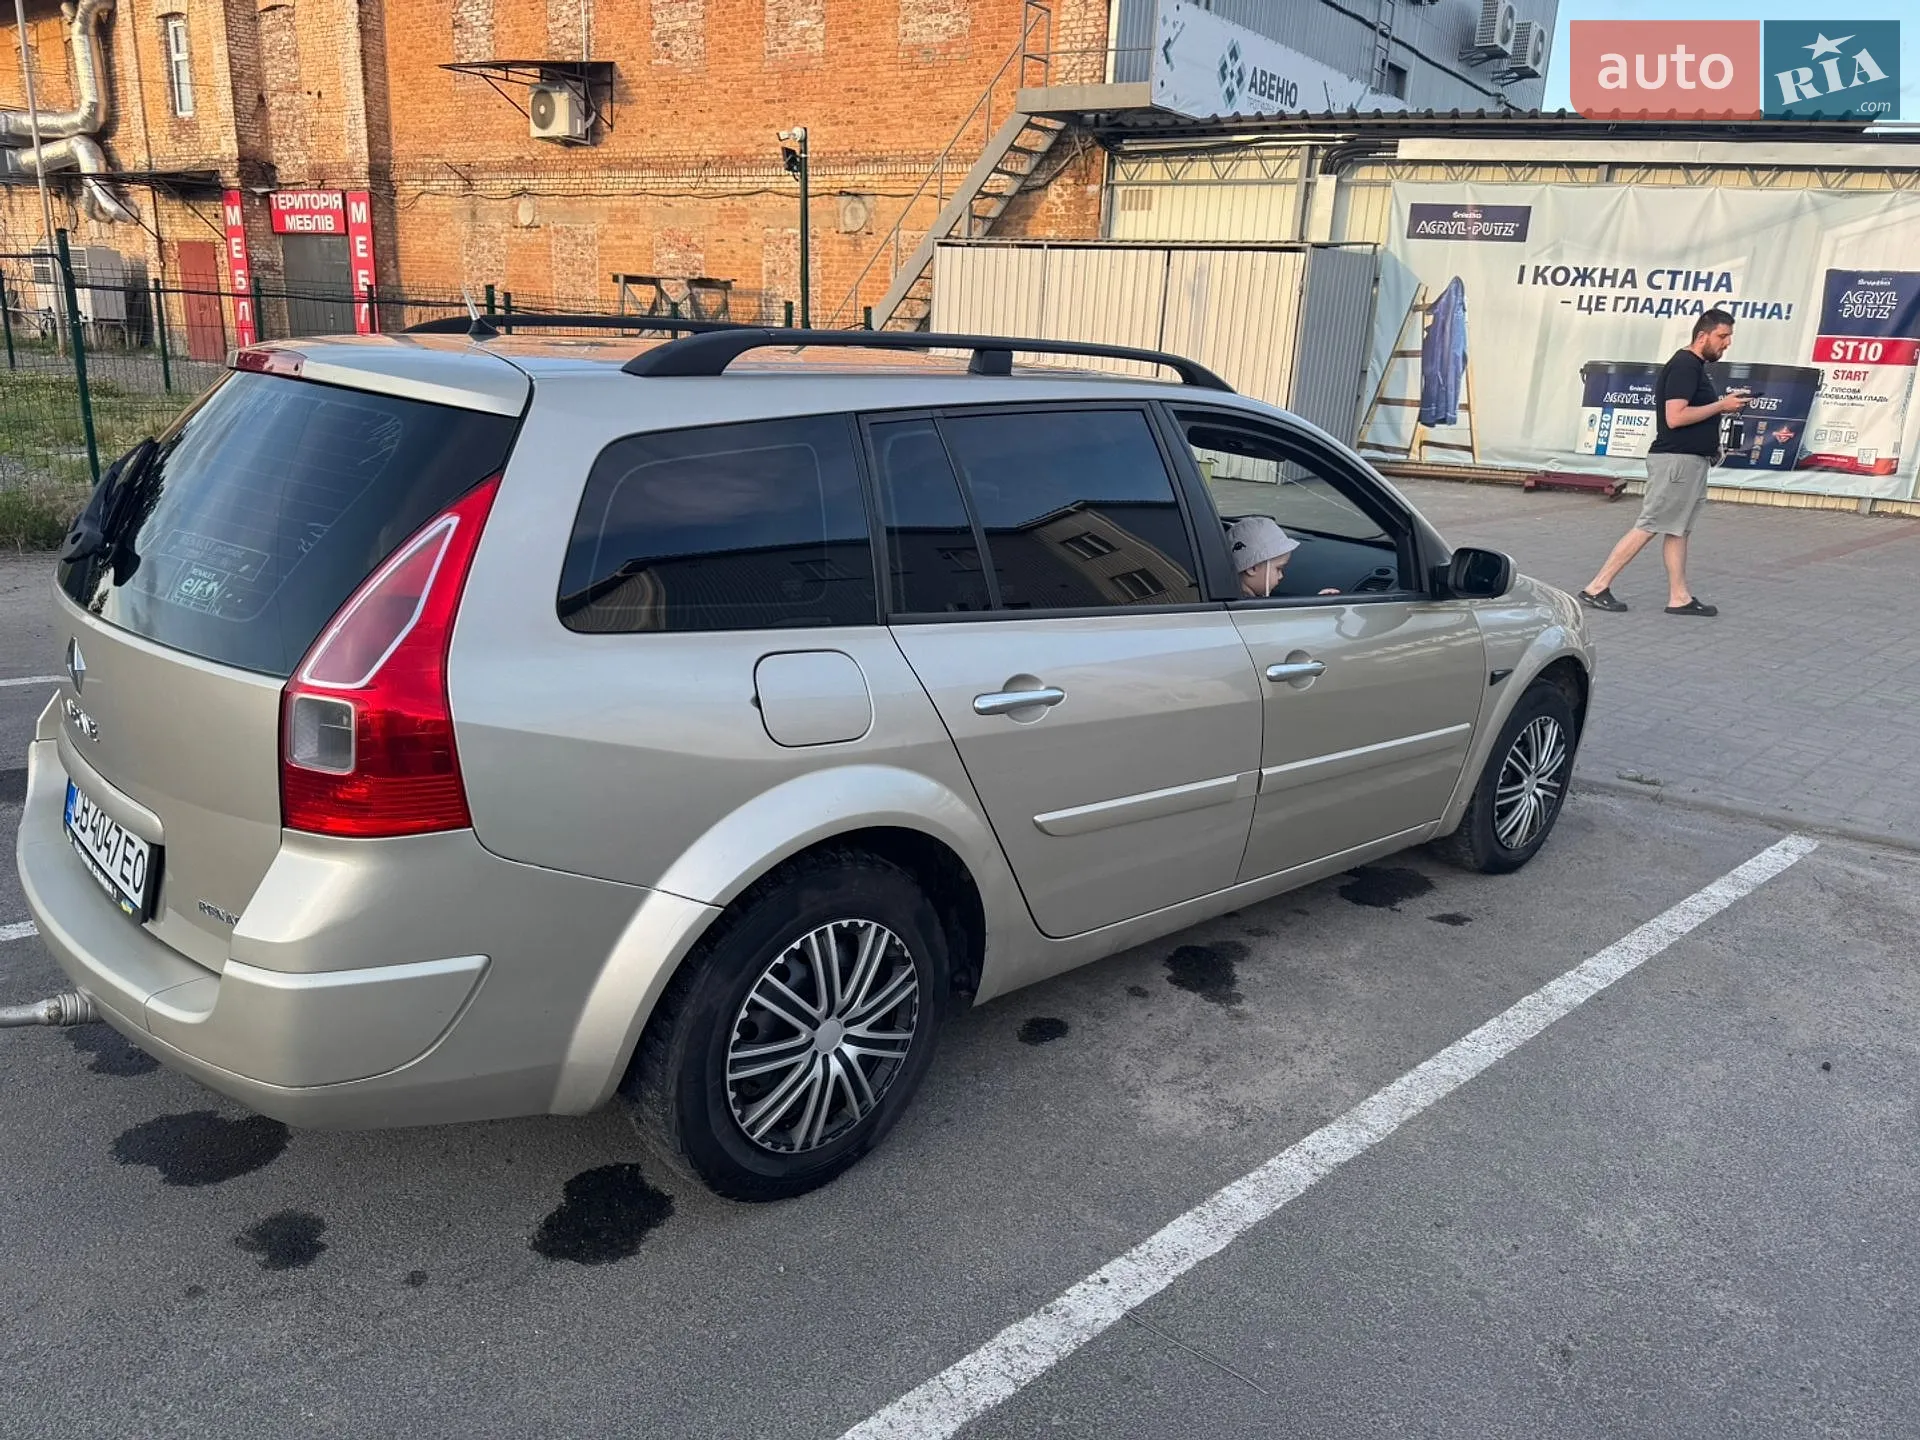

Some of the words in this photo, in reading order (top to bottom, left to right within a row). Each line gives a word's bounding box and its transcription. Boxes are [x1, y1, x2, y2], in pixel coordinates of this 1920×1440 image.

[1248, 66, 1298, 109] АВЕНЮ
[270, 193, 343, 210] ТЕРИТОРІЯ
[284, 214, 335, 231] МЕБЛІВ
[1531, 265, 1638, 289] КОЖНА
[1646, 269, 1733, 293] СТІНА
[1576, 294, 1608, 315] ЦЕ
[1612, 296, 1705, 318] ГЛАДКА
[1830, 340, 1883, 362] ST10
[1832, 369, 1869, 381] START
[1602, 391, 1656, 405] ACRYL-P
[1598, 413, 1611, 445] FS20
[1616, 415, 1650, 427] FINISZ
